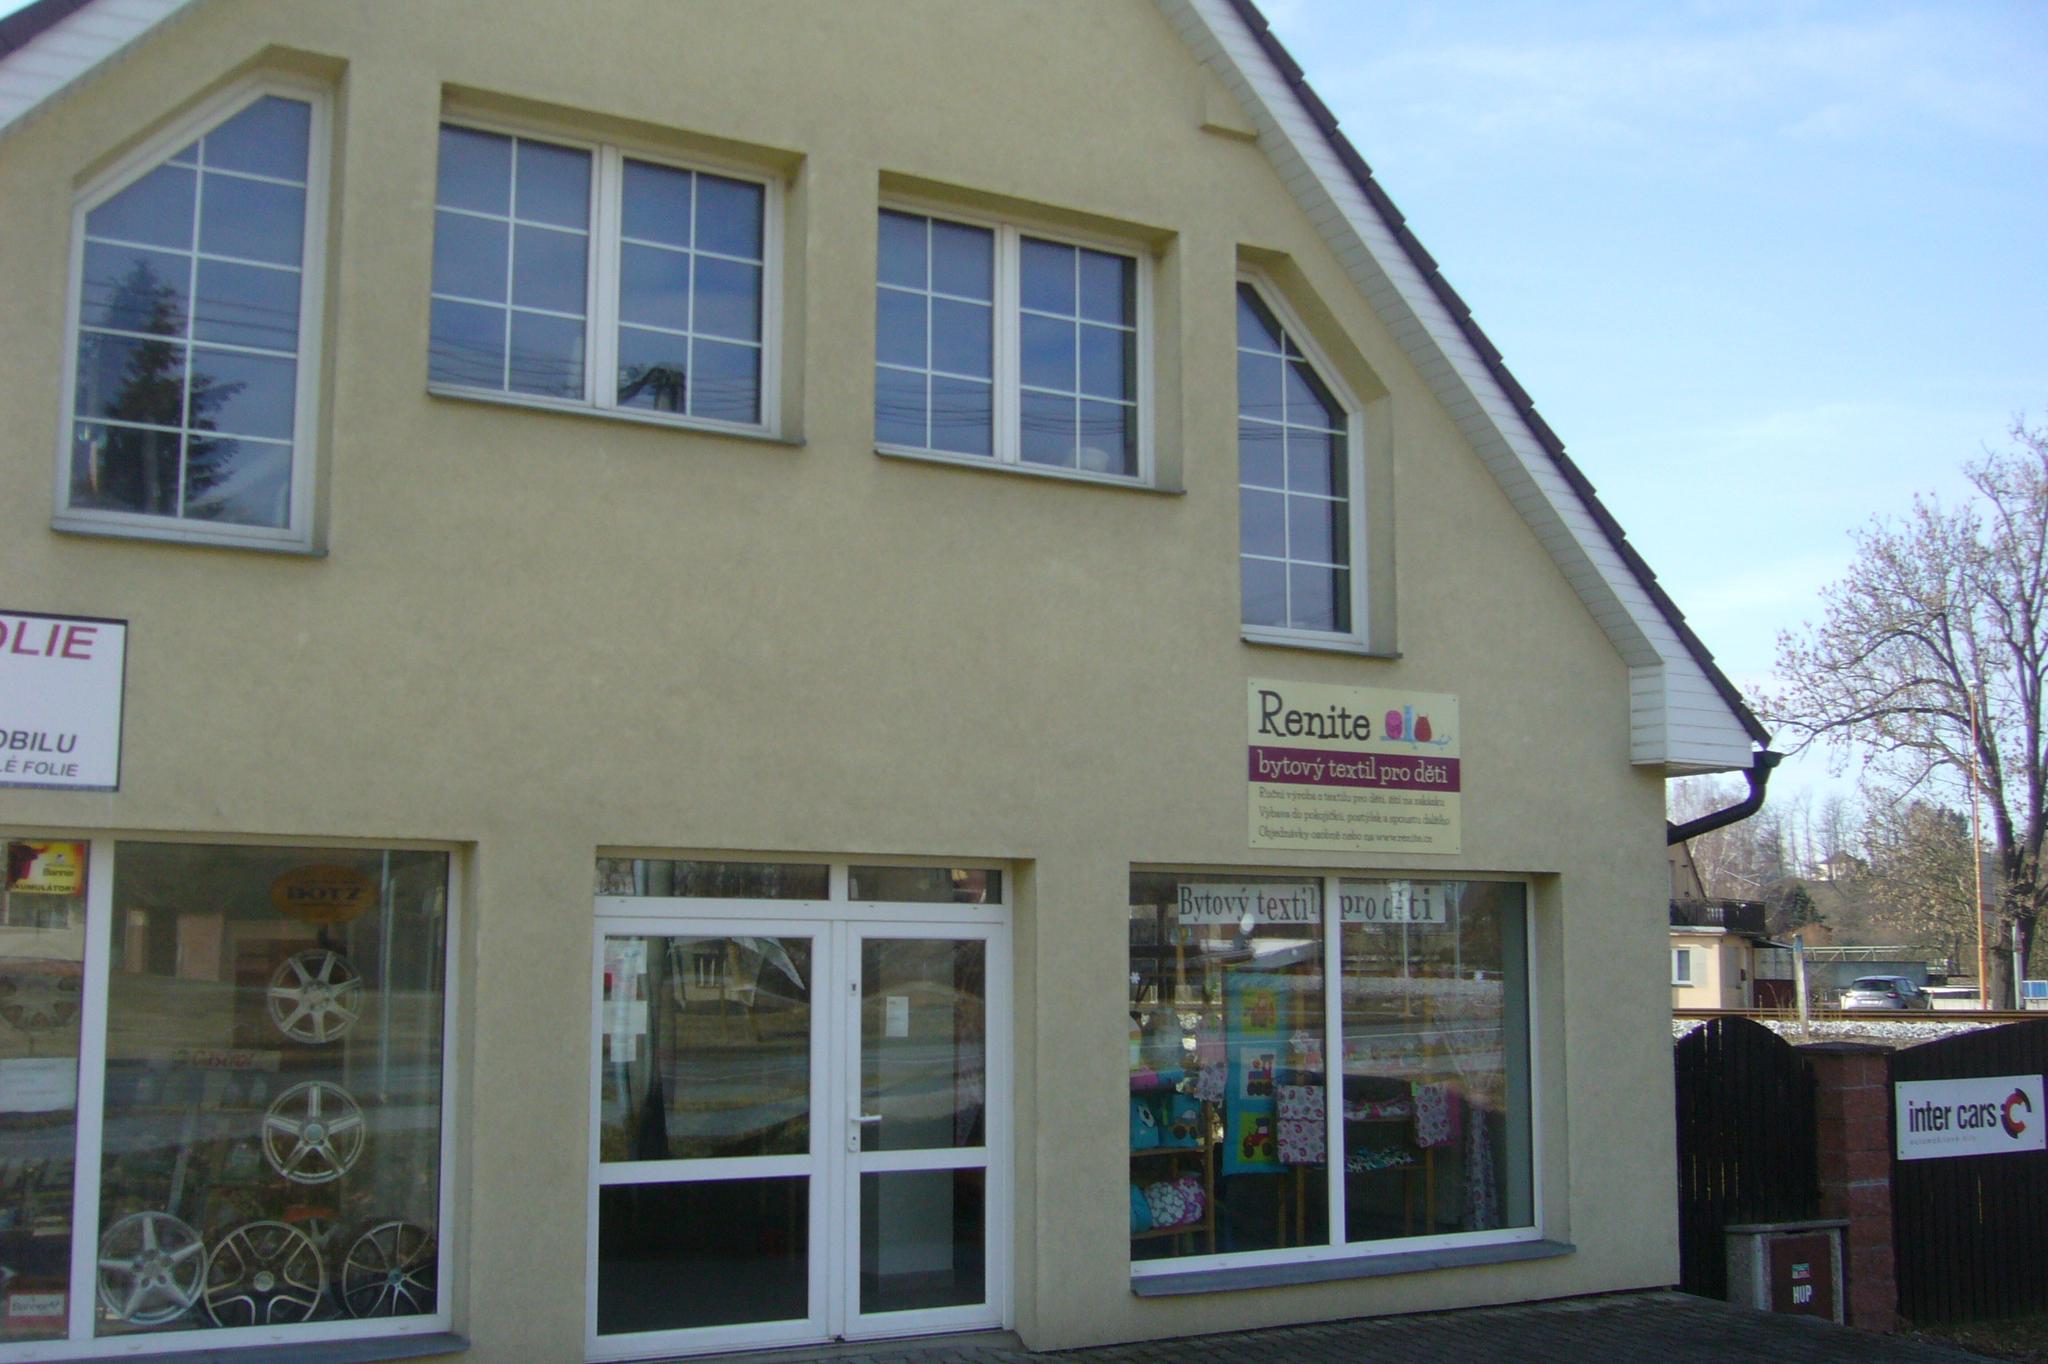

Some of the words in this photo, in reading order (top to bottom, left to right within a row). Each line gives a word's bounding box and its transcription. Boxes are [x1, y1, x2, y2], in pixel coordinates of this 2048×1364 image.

[0, 619, 98, 661] LIE
[1258, 690, 1371, 741] Renite
[22, 760, 80, 778] FOLIE
[1258, 749, 1325, 781] bytový
[1328, 757, 1376, 781] textil
[1379, 765, 1411, 785] pro
[1413, 760, 1449, 784] děti
[1179, 886, 1249, 922] Bytový
[1257, 885, 1318, 921] textil
[1339, 893, 1377, 921] pro
[1908, 1100, 1952, 1134] inter
[1956, 1101, 1997, 1130] cars
[1792, 1284, 1813, 1305] HUP
